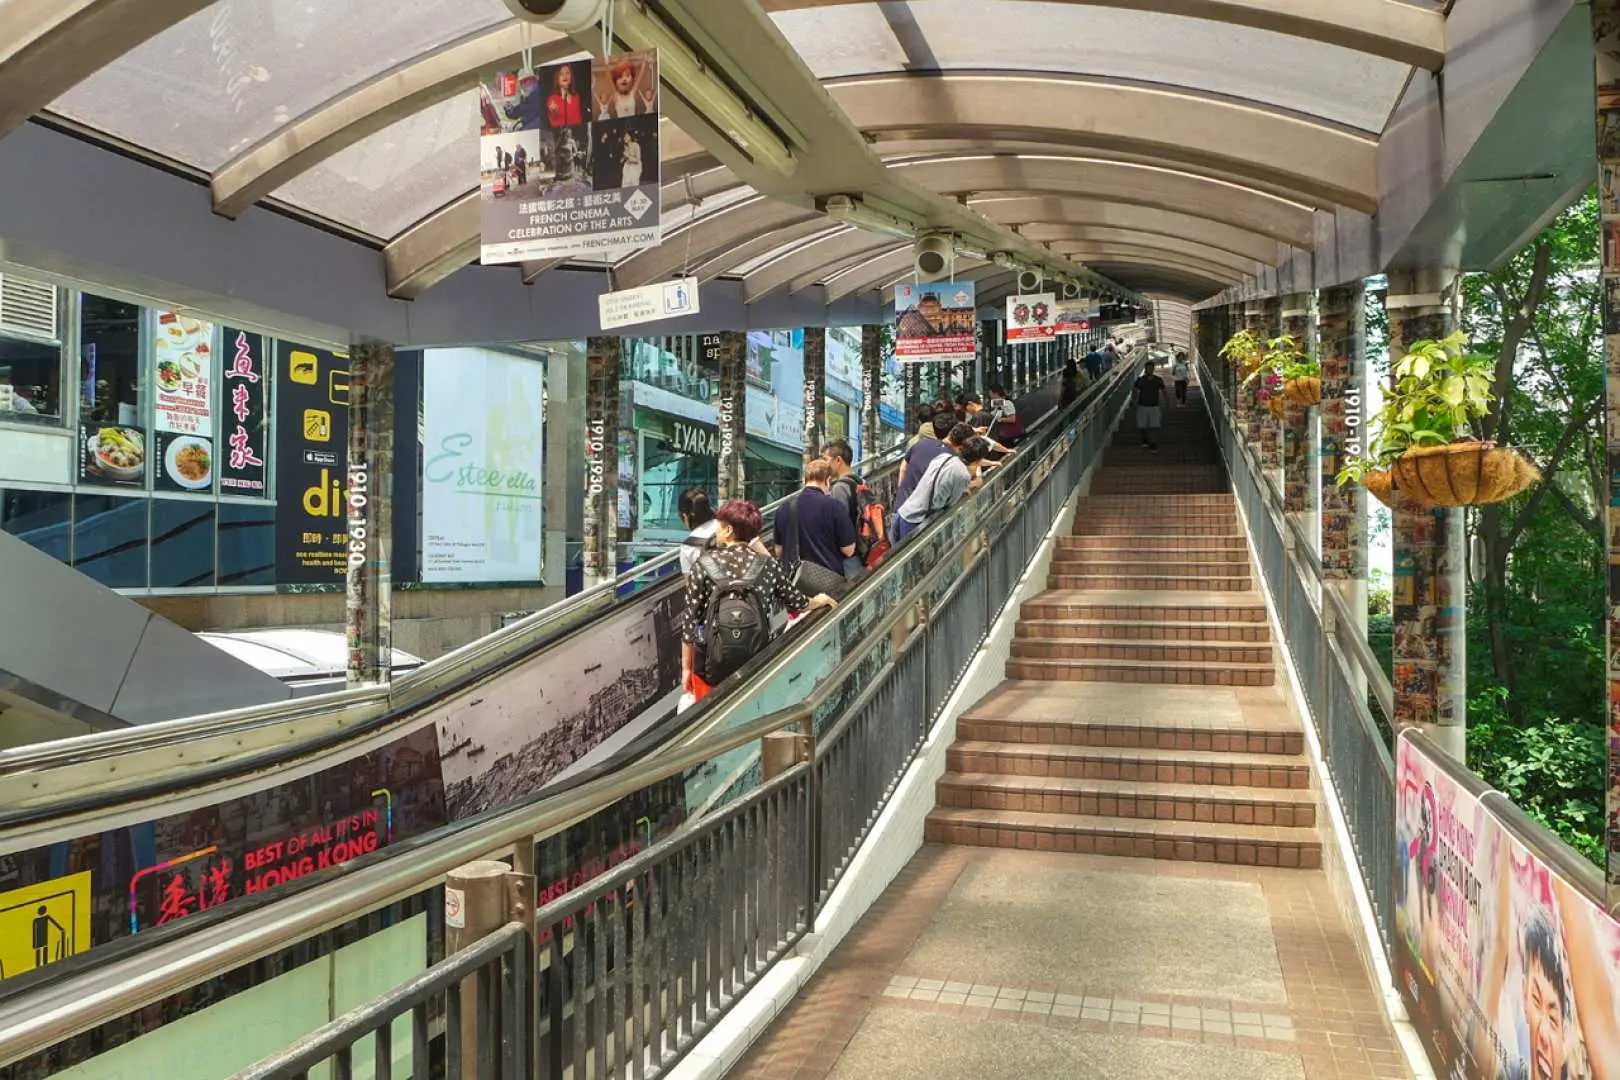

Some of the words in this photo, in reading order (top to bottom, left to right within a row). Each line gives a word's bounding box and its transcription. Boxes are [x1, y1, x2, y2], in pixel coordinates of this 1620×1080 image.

[508, 224, 573, 239] CELEBRATION
[574, 222, 588, 233] OF
[590, 220, 607, 231] THE
[608, 216, 633, 228] ARTS
[529, 209, 568, 225] FRENCH
[570, 207, 610, 221] CINEMA
[582, 232, 656, 249] FRENCHMAY.COM
[703, 335, 720, 346] na
[721, 396, 733, 455] 1910-1930
[805, 380, 816, 429] 1930-1960
[590, 419, 604, 493] 1910-1930
[303, 468, 349, 517] di
[349, 463, 368, 567] 1910-1930
[243, 841, 284, 871] BEST
[287, 832, 307, 853] OF
[311, 827, 333, 847] ALL
[336, 815, 360, 837] IT'S
[362, 809, 379, 826] IN
[244, 859, 314, 895] HONG
[318, 831, 378, 870] KONG
